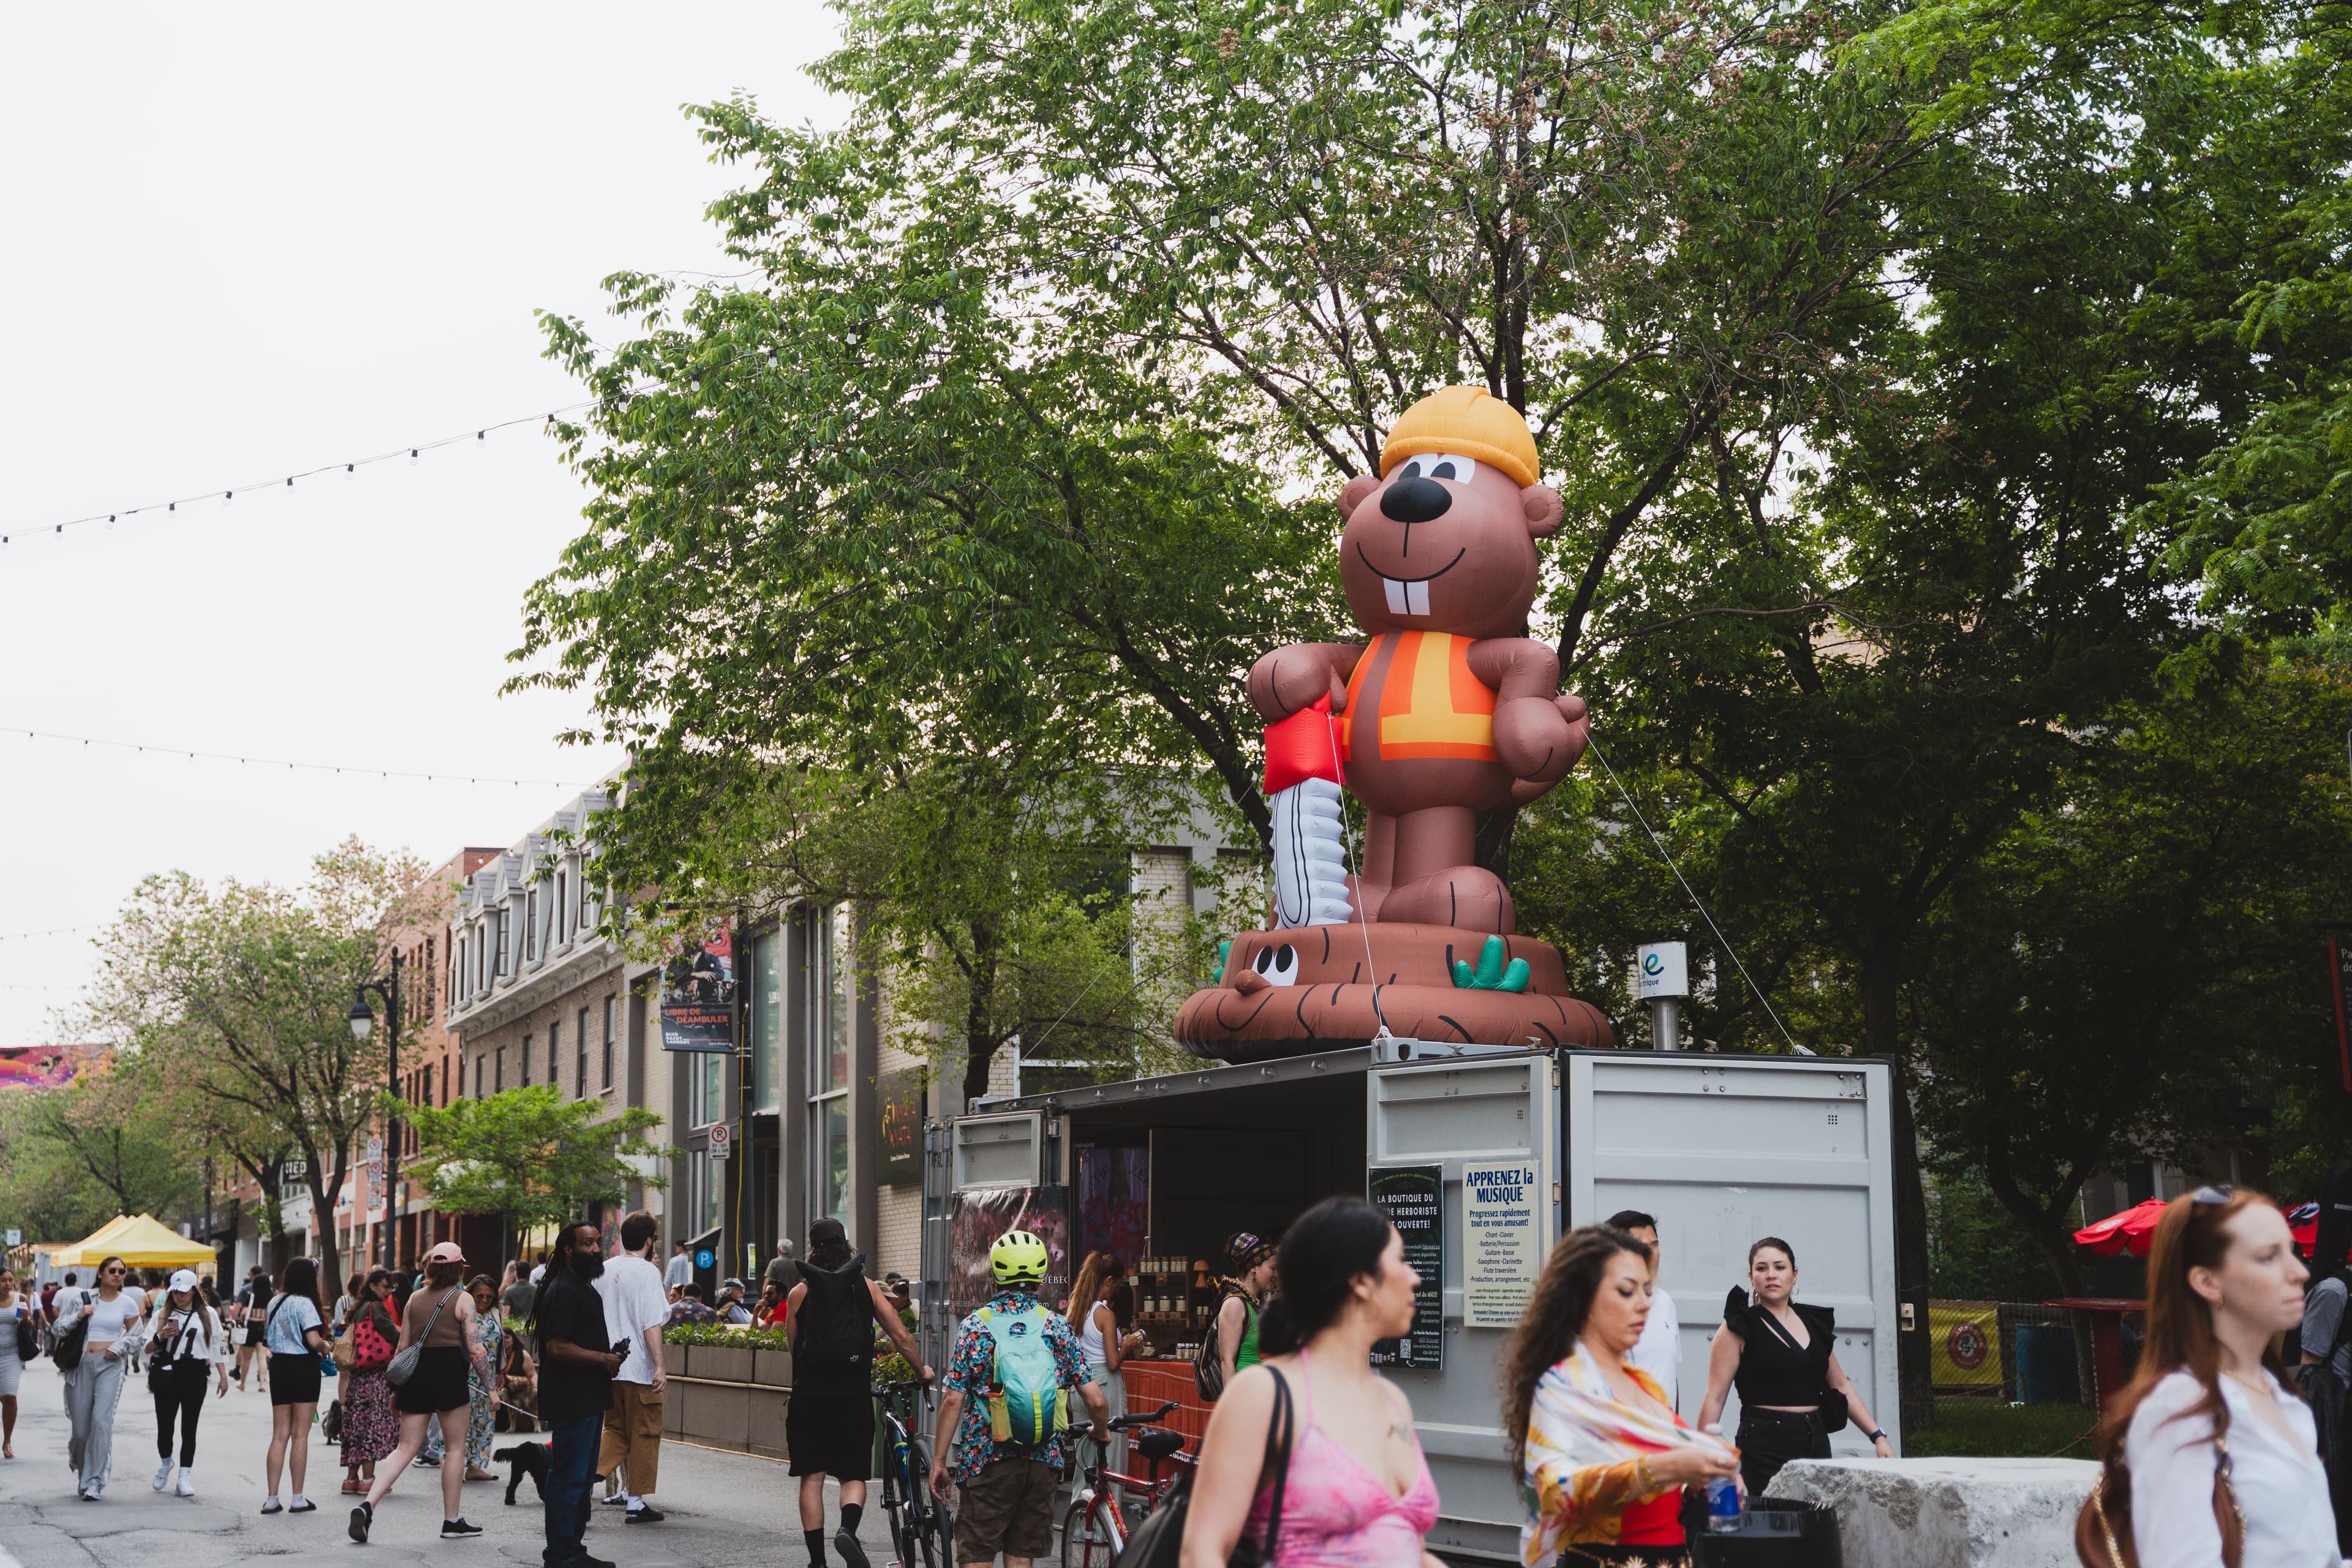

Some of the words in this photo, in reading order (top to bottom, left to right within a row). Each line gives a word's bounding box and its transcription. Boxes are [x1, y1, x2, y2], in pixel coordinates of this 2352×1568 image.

[1466, 1170, 1520, 1186] APPRENEZ
[1524, 1167, 1533, 1184] la
[1388, 1194, 1421, 1202] BOUTIQUE
[1424, 1193, 1433, 1202] DU
[1477, 1186, 1523, 1205] MUSIQUE
[1397, 1207, 1437, 1215] HERBORISTE
[1470, 1210, 1498, 1219] Progressez
[1499, 1208, 1530, 1219] rapidement
[1398, 1219, 1430, 1229] OUVERTE!
[700, 1253, 709, 1265] P
